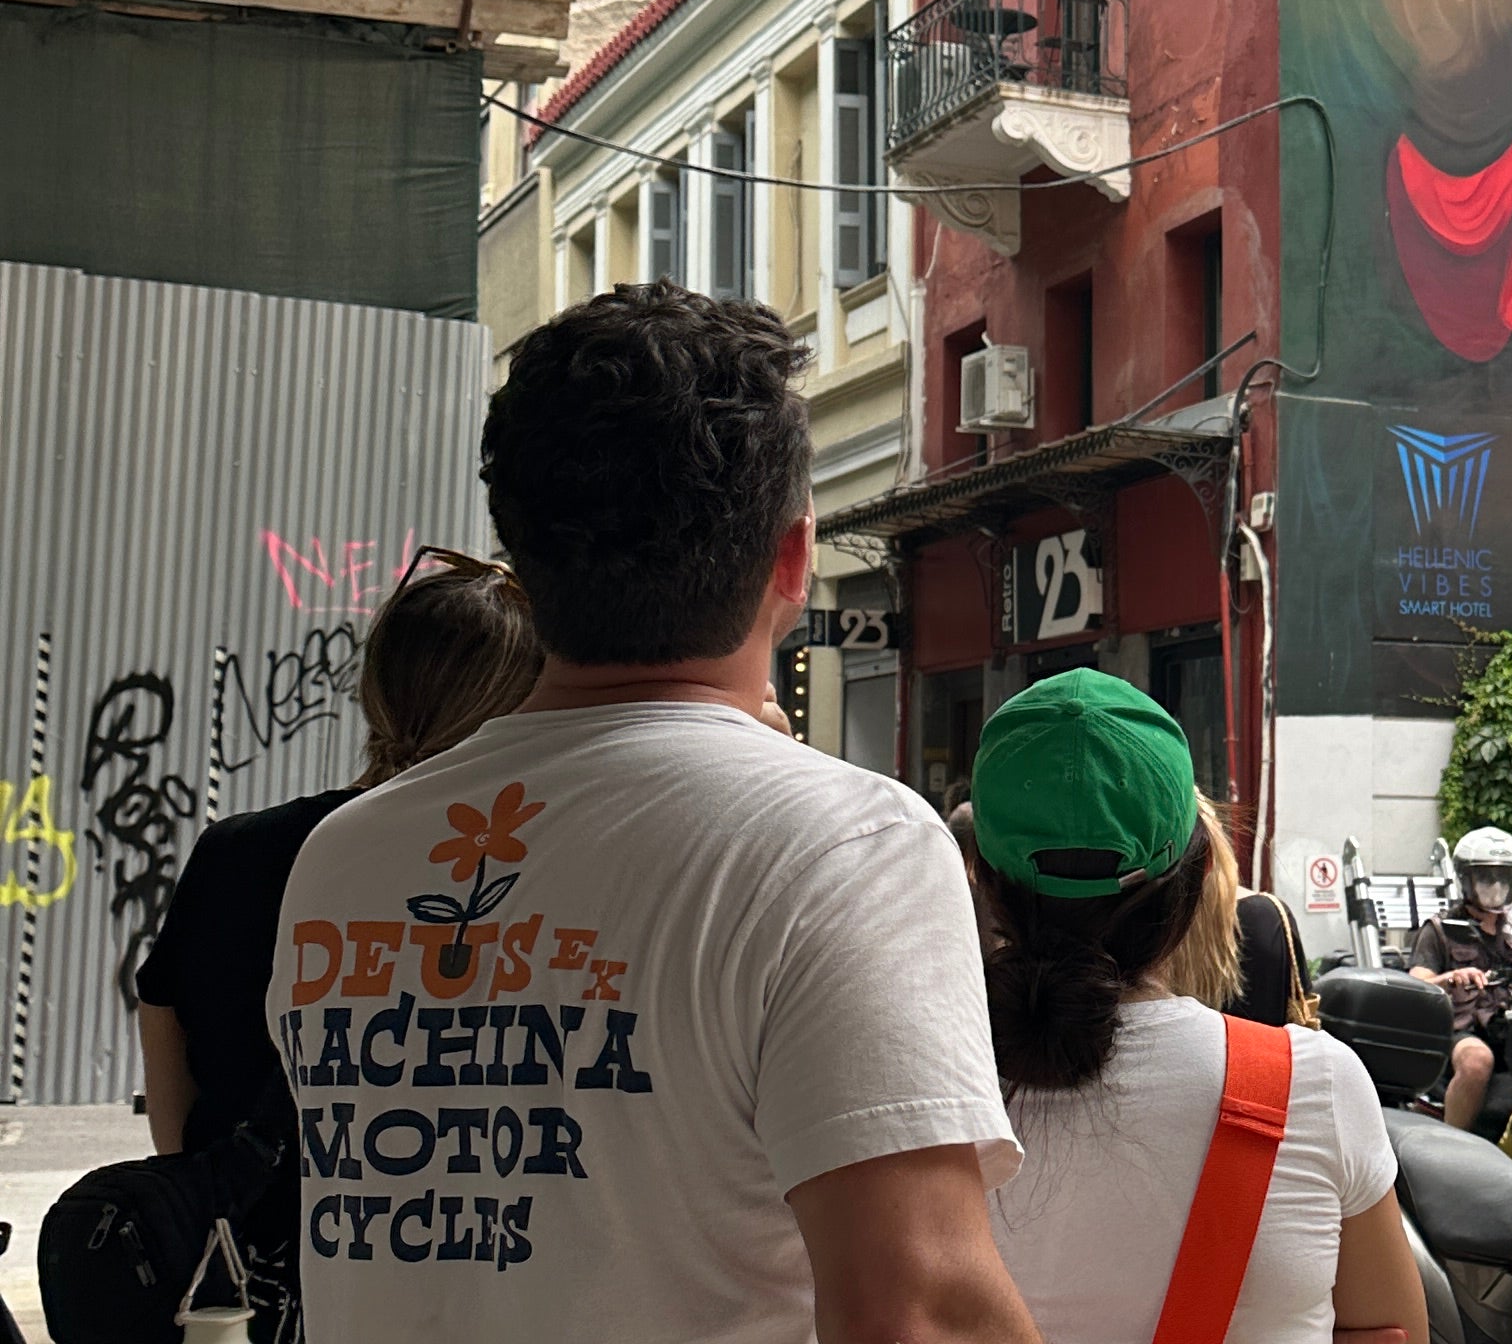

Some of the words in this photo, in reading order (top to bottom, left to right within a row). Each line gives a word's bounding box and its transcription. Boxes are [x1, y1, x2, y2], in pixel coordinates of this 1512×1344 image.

[1001, 563, 1013, 633] Retro
[1035, 529, 1090, 640] 23
[1398, 545, 1493, 571] HELLENIC
[1399, 573, 1493, 598] VIBES
[840, 608, 888, 649] 23
[1399, 599, 1446, 616] SMART
[1449, 601, 1493, 618] HOTEL
[292, 913, 545, 1006] DEUS
[301, 1102, 588, 1179] MOTOR
[310, 1189, 533, 1272] CYCLES
